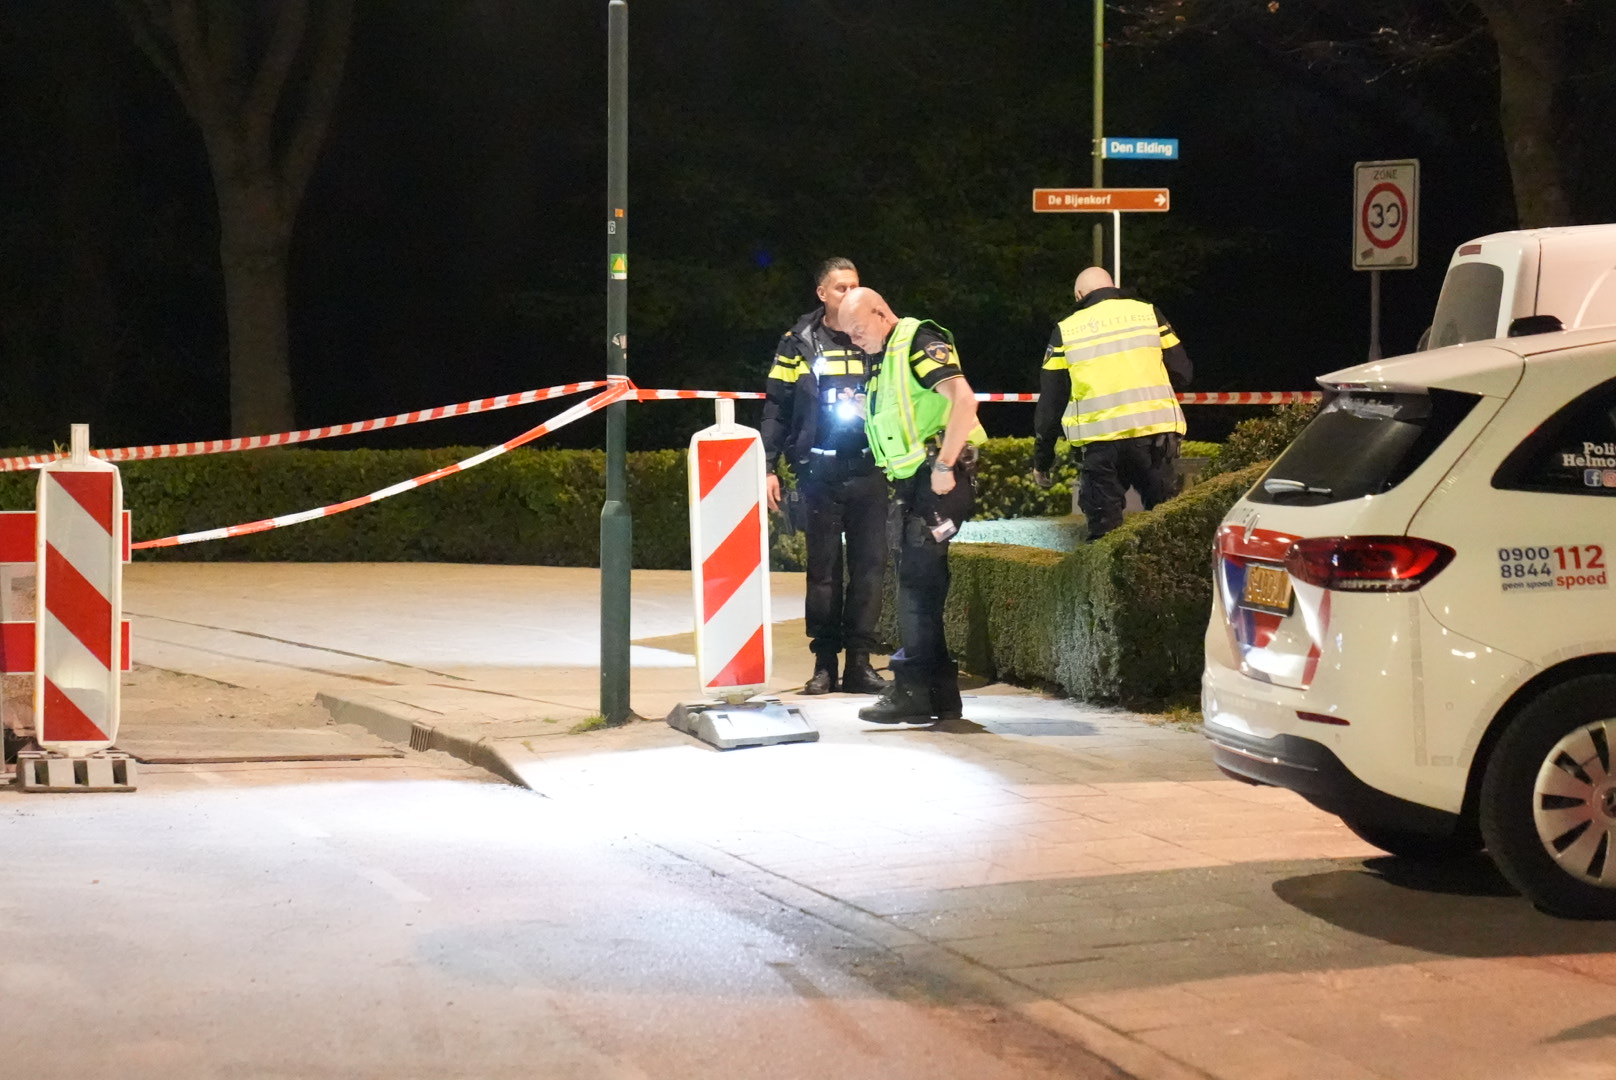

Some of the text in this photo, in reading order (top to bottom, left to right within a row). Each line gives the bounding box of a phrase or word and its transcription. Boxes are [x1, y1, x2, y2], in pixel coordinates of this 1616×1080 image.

[1111, 142, 1172, 156] Den Elding
[1373, 169, 1398, 180] ZONE
[1048, 194, 1111, 207] De Bijenkorf
[1370, 203, 1401, 228] 30
[1582, 442, 1616, 455] Poli
[1499, 547, 1550, 562] 0900
[1553, 545, 1605, 570] 112
[1501, 563, 1552, 578] 8844
[1556, 571, 1607, 589] spoed
